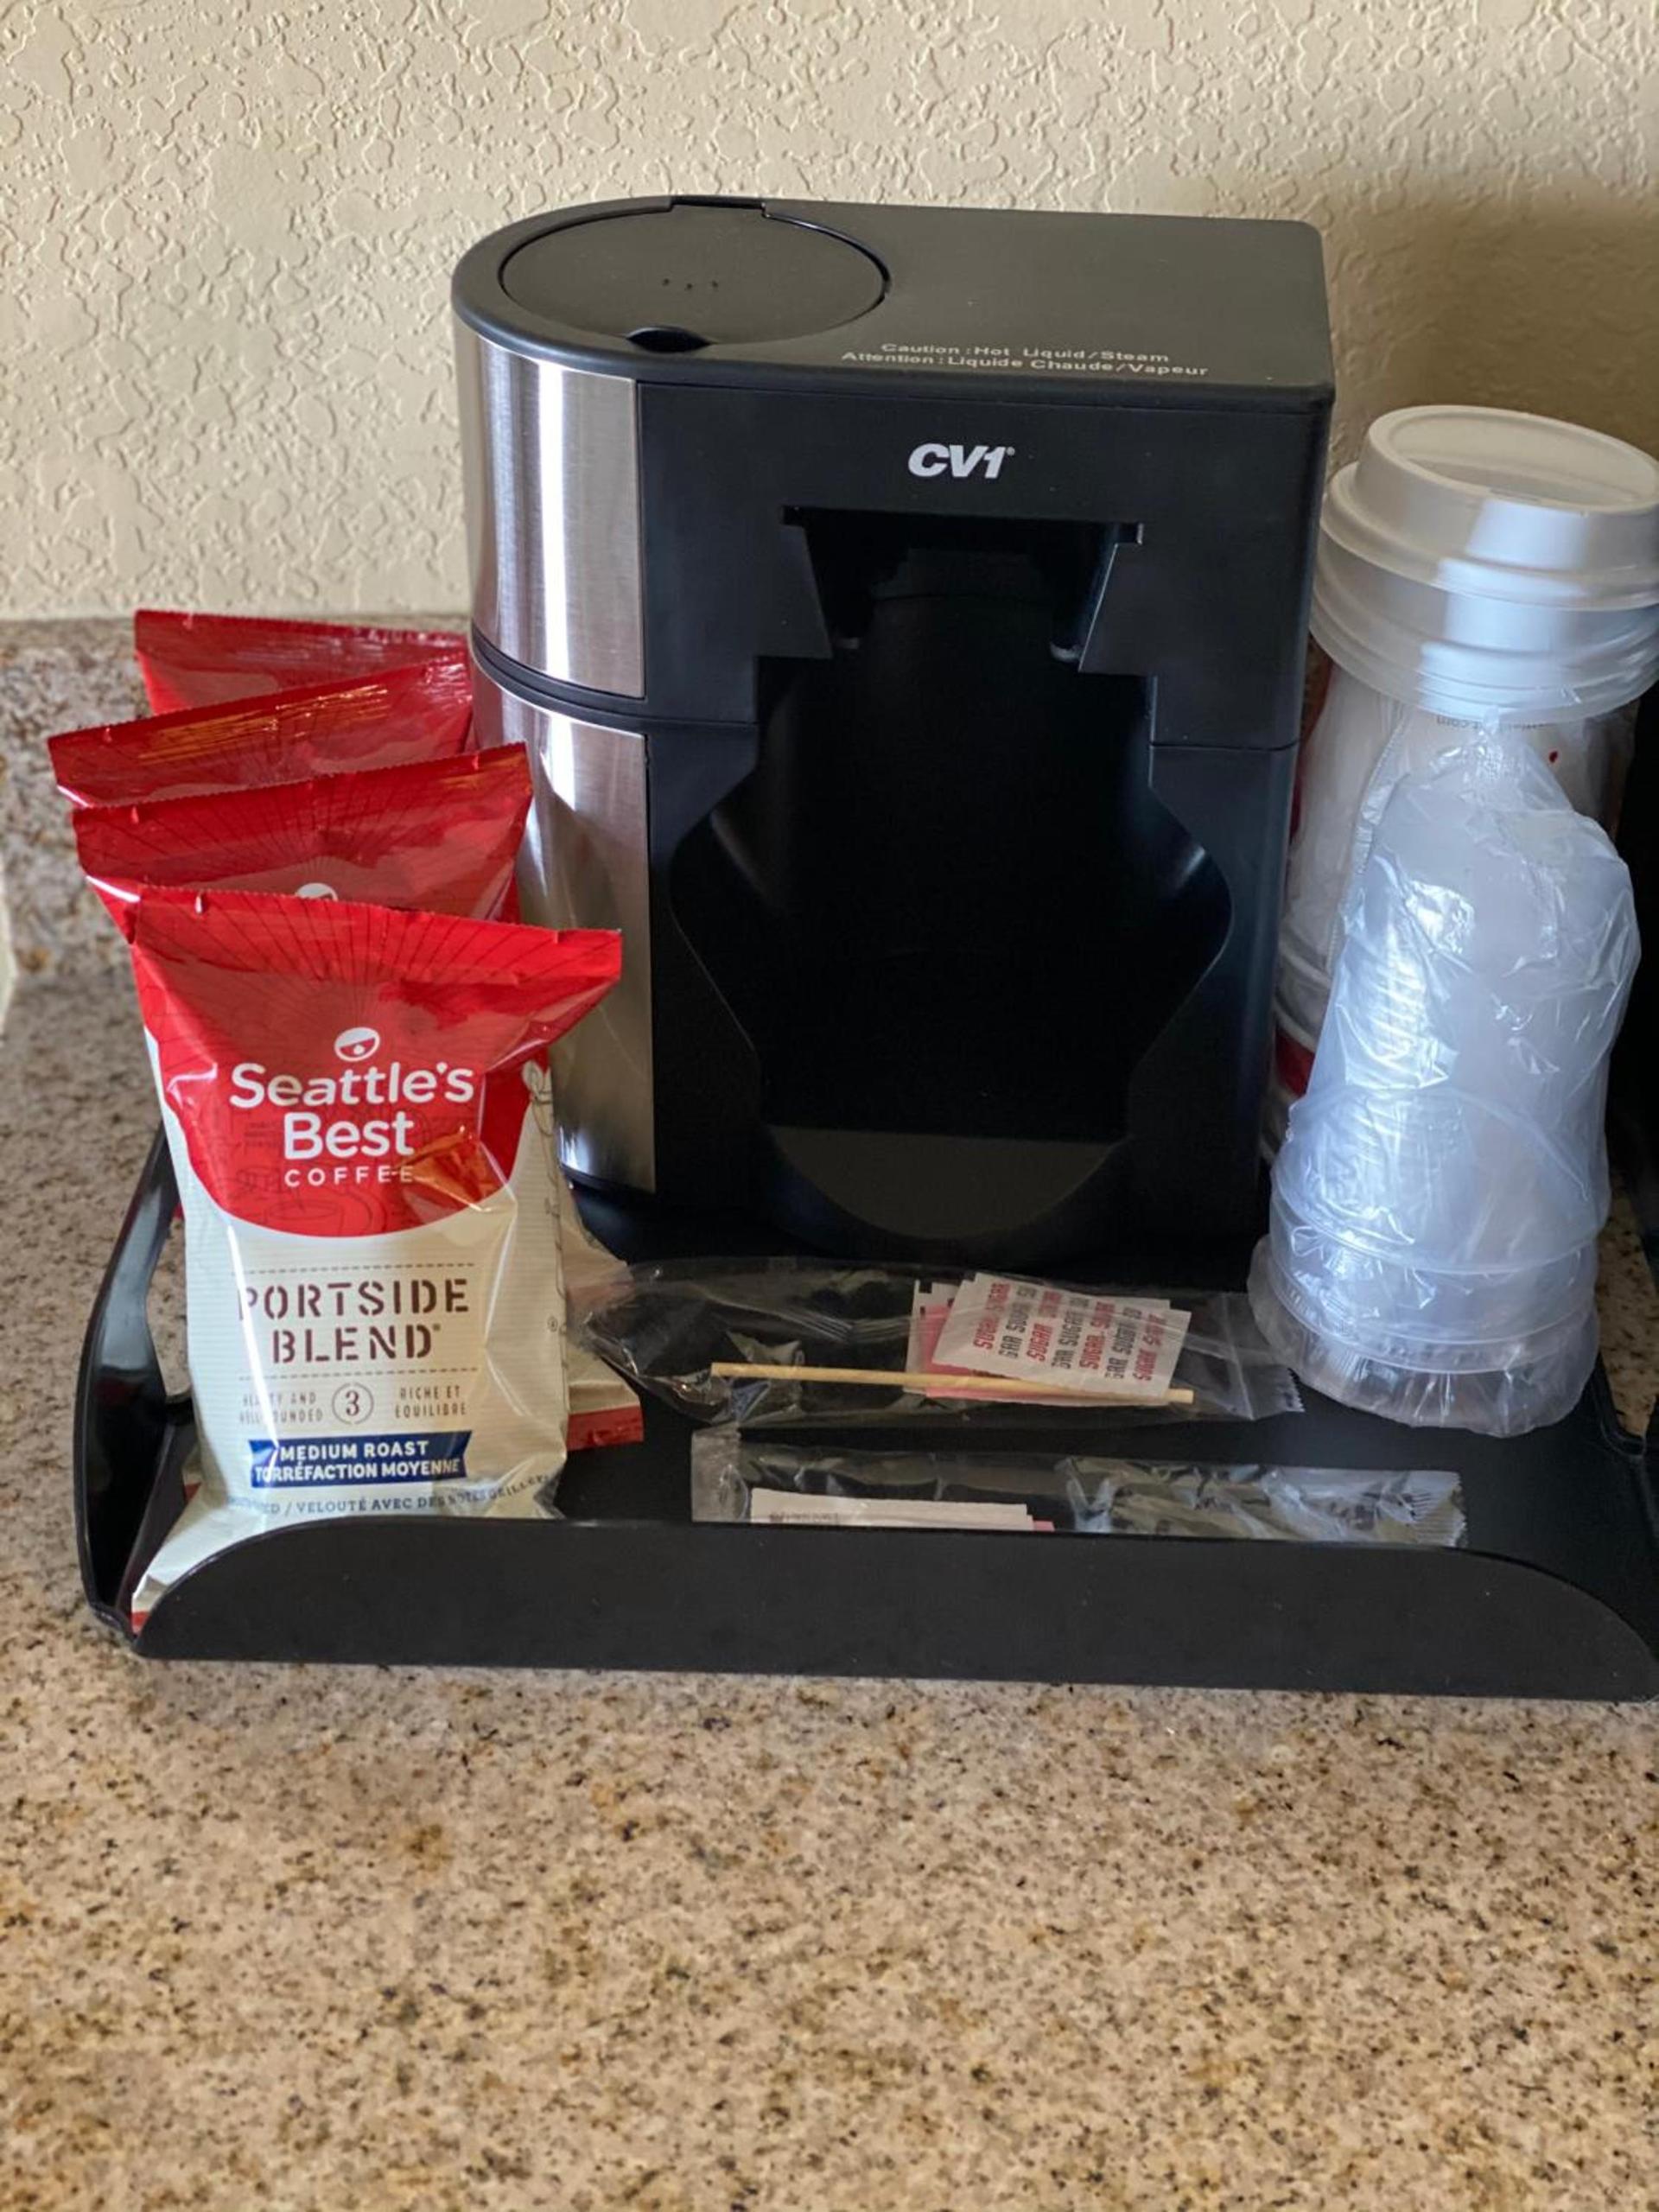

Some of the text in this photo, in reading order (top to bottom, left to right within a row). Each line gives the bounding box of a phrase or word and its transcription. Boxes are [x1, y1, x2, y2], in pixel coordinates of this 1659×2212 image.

[229, 1061, 475, 1109] Seattle's
[283, 1111, 415, 1160] Best
[284, 1165, 415, 1188] COFFEE
[238, 1279, 470, 1320] PORTSIDE
[1058, 1311, 1084, 1347] SUGAR
[1027, 1323, 1053, 1362] SUGAR
[1078, 1334, 1105, 1370] SUGAR
[290, 1391, 317, 1406] AND
[345, 1390, 360, 1416] 3
[446, 1384, 461, 1399] ET
[280, 1440, 429, 1462] MEDIUM ROAST
[256, 1458, 461, 1483] TORRÉFACTION MOYENNE
[295, 1497, 366, 1513] VELOUTÉ
[372, 1497, 413, 1510] AVEC
